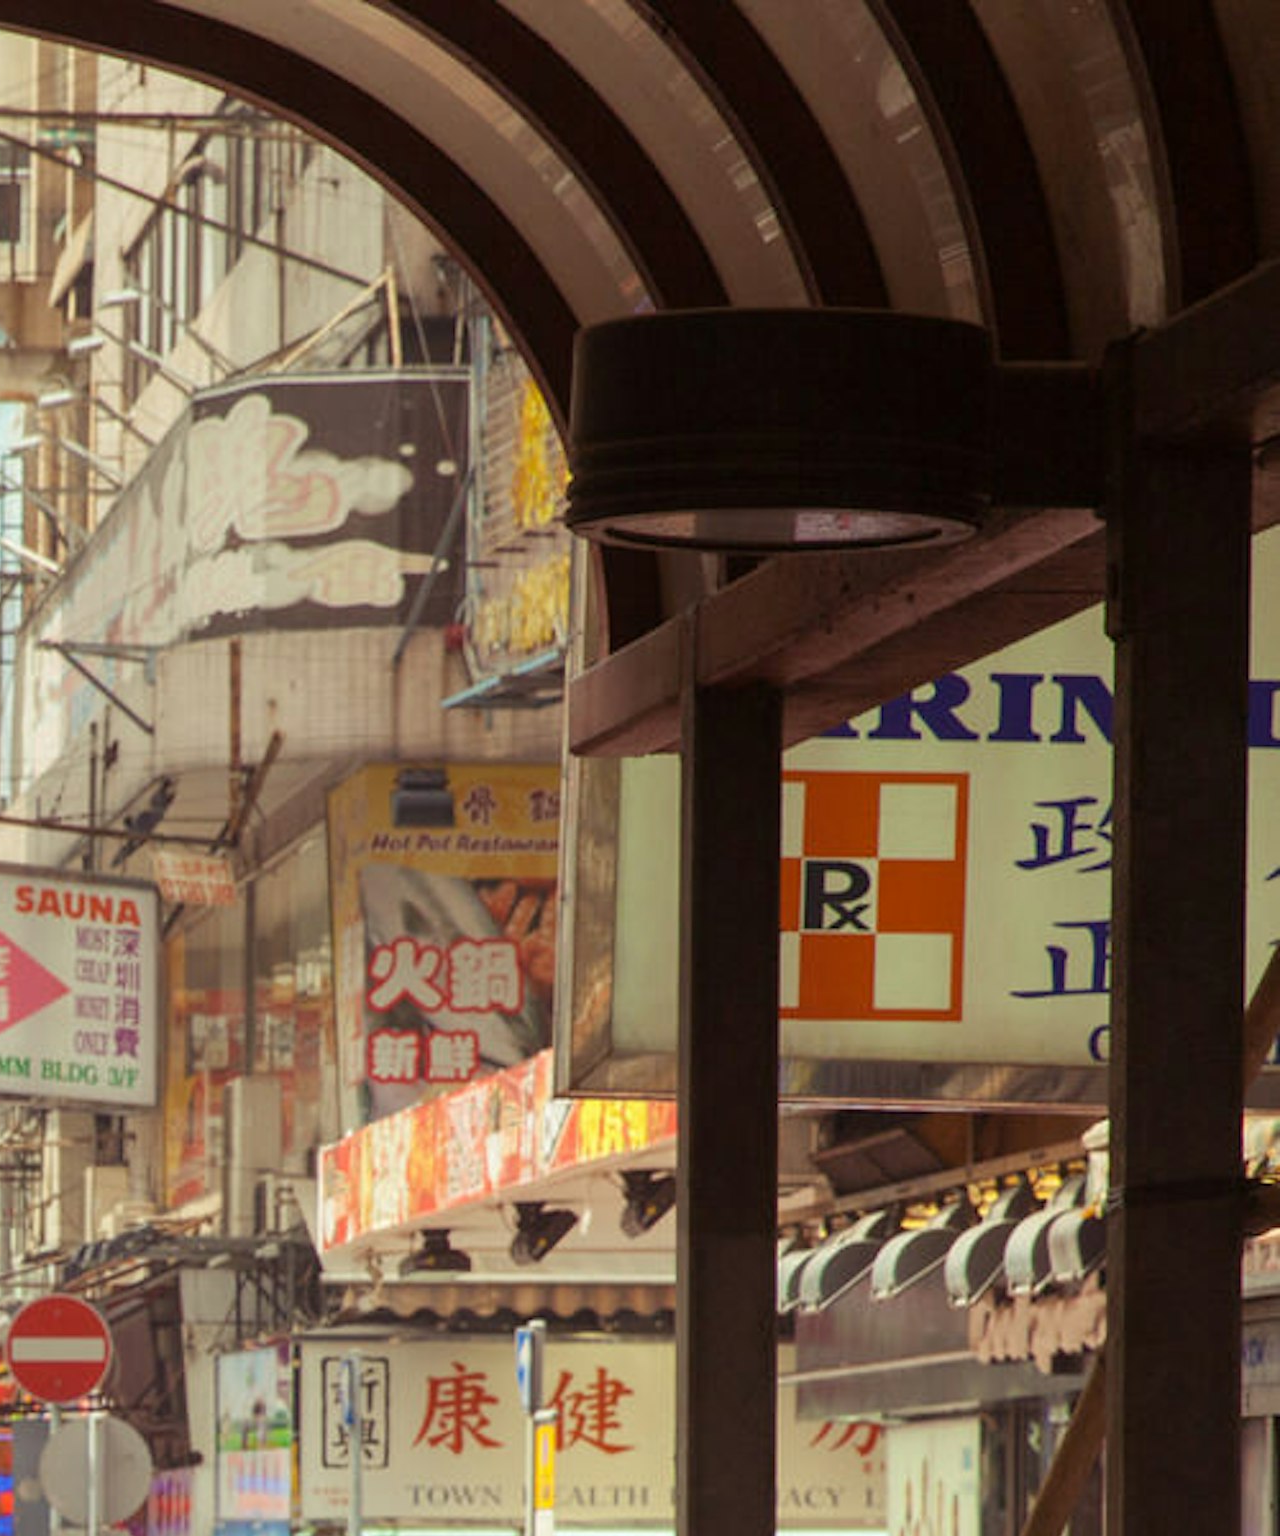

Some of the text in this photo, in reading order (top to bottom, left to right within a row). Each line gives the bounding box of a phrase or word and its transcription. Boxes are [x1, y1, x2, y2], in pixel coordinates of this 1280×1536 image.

[15, 885, 142, 927] SAUNA
[113, 928, 141, 1059] 深圳消費
[368, 936, 524, 1014] 火鍋
[40, 1060, 100, 1086] BLDG
[368, 1028, 480, 1083] 新鮮
[408, 1484, 504, 1508] TOWN
